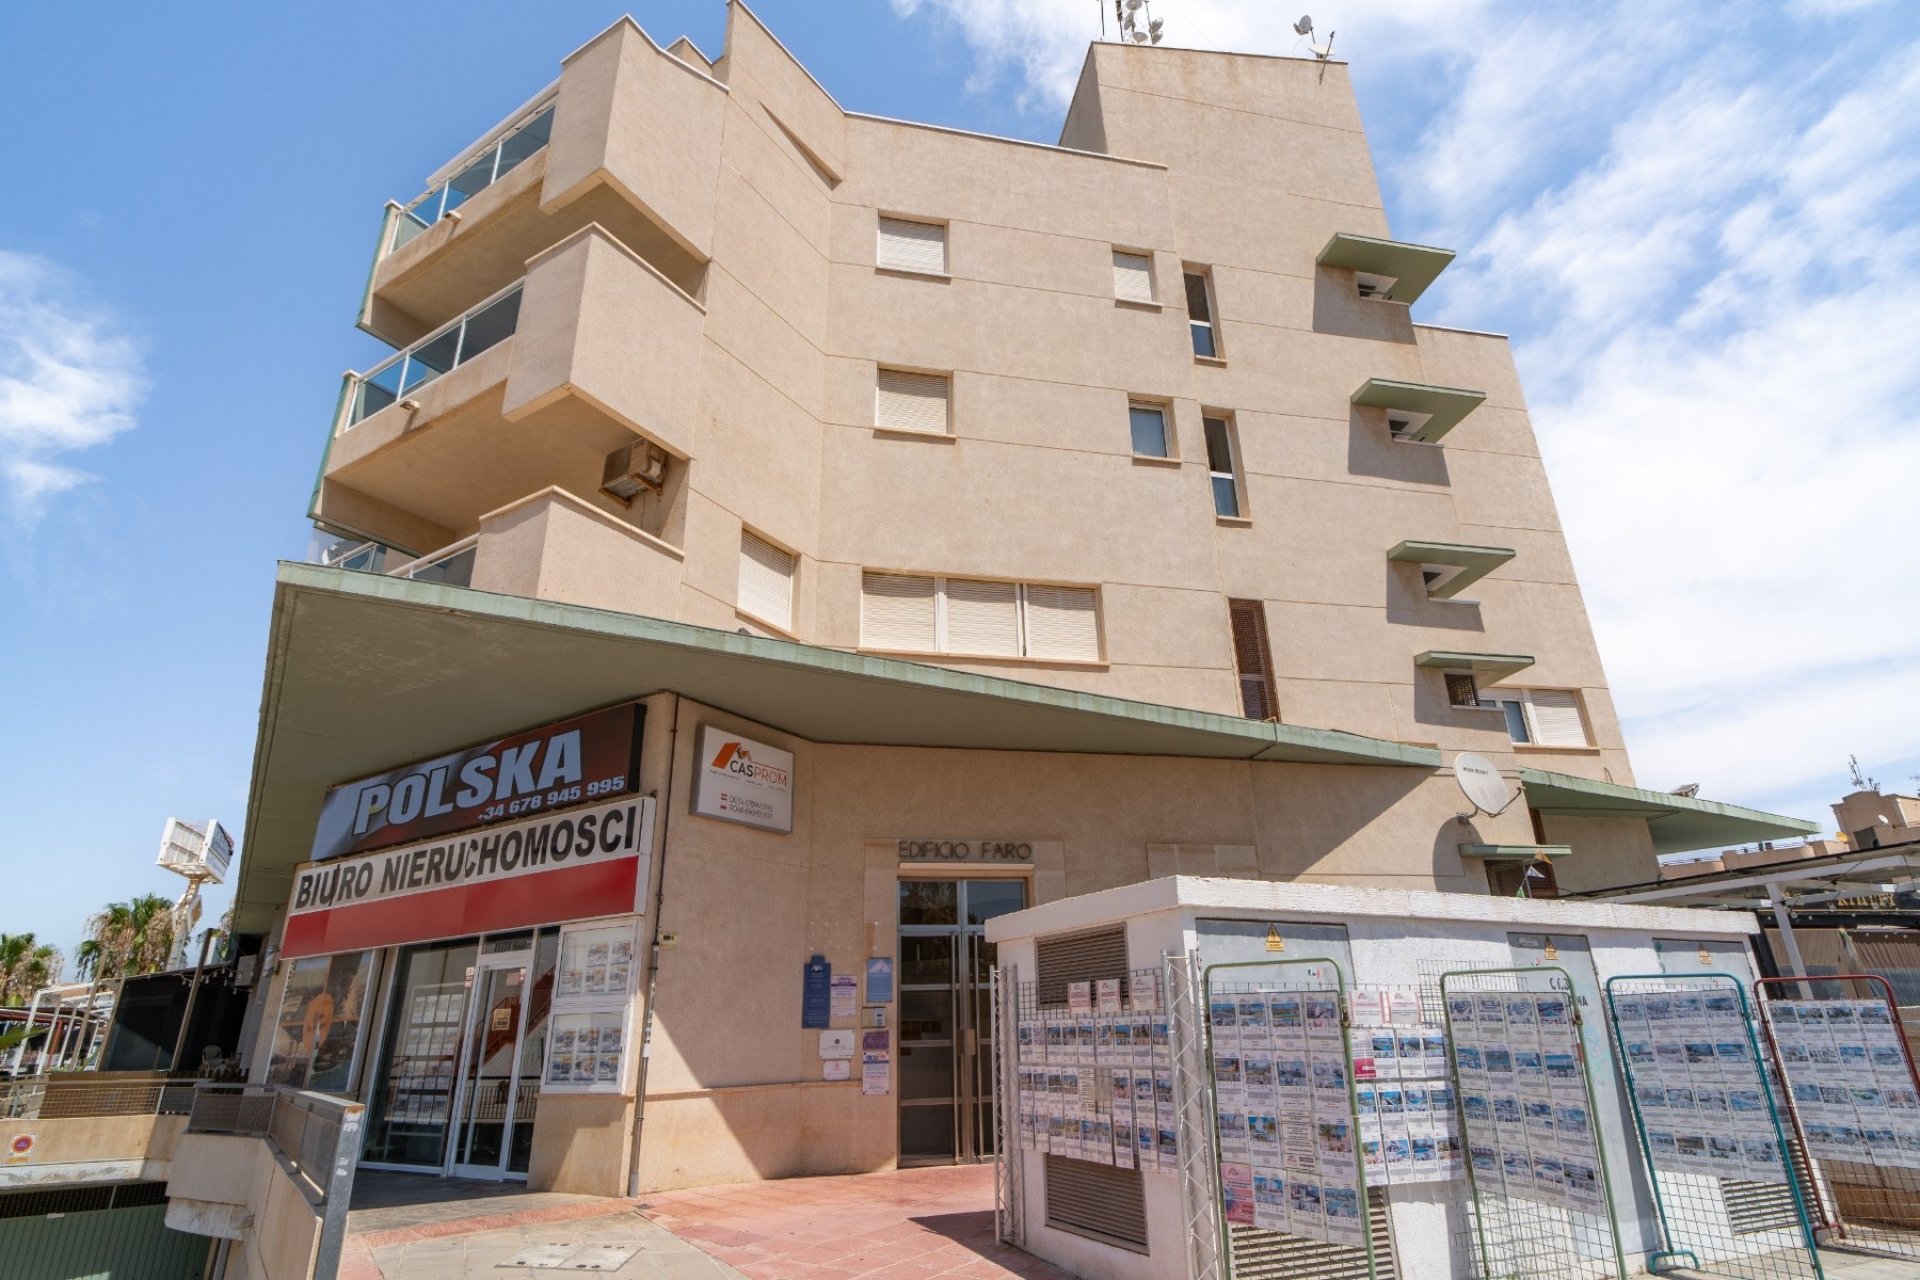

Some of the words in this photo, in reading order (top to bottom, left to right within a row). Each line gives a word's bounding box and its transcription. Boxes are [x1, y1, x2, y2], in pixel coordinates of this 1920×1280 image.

[353, 729, 582, 835] POLSKA
[730, 760, 787, 787] CASPROM
[509, 795, 542, 813] 678
[547, 786, 581, 804] 945
[587, 776, 624, 796] 995
[295, 862, 373, 909] BIURO
[380, 806, 637, 893] NIERUCHOMOSCI
[899, 841, 970, 859] EDIFICIO
[980, 842, 1033, 860] FARO
